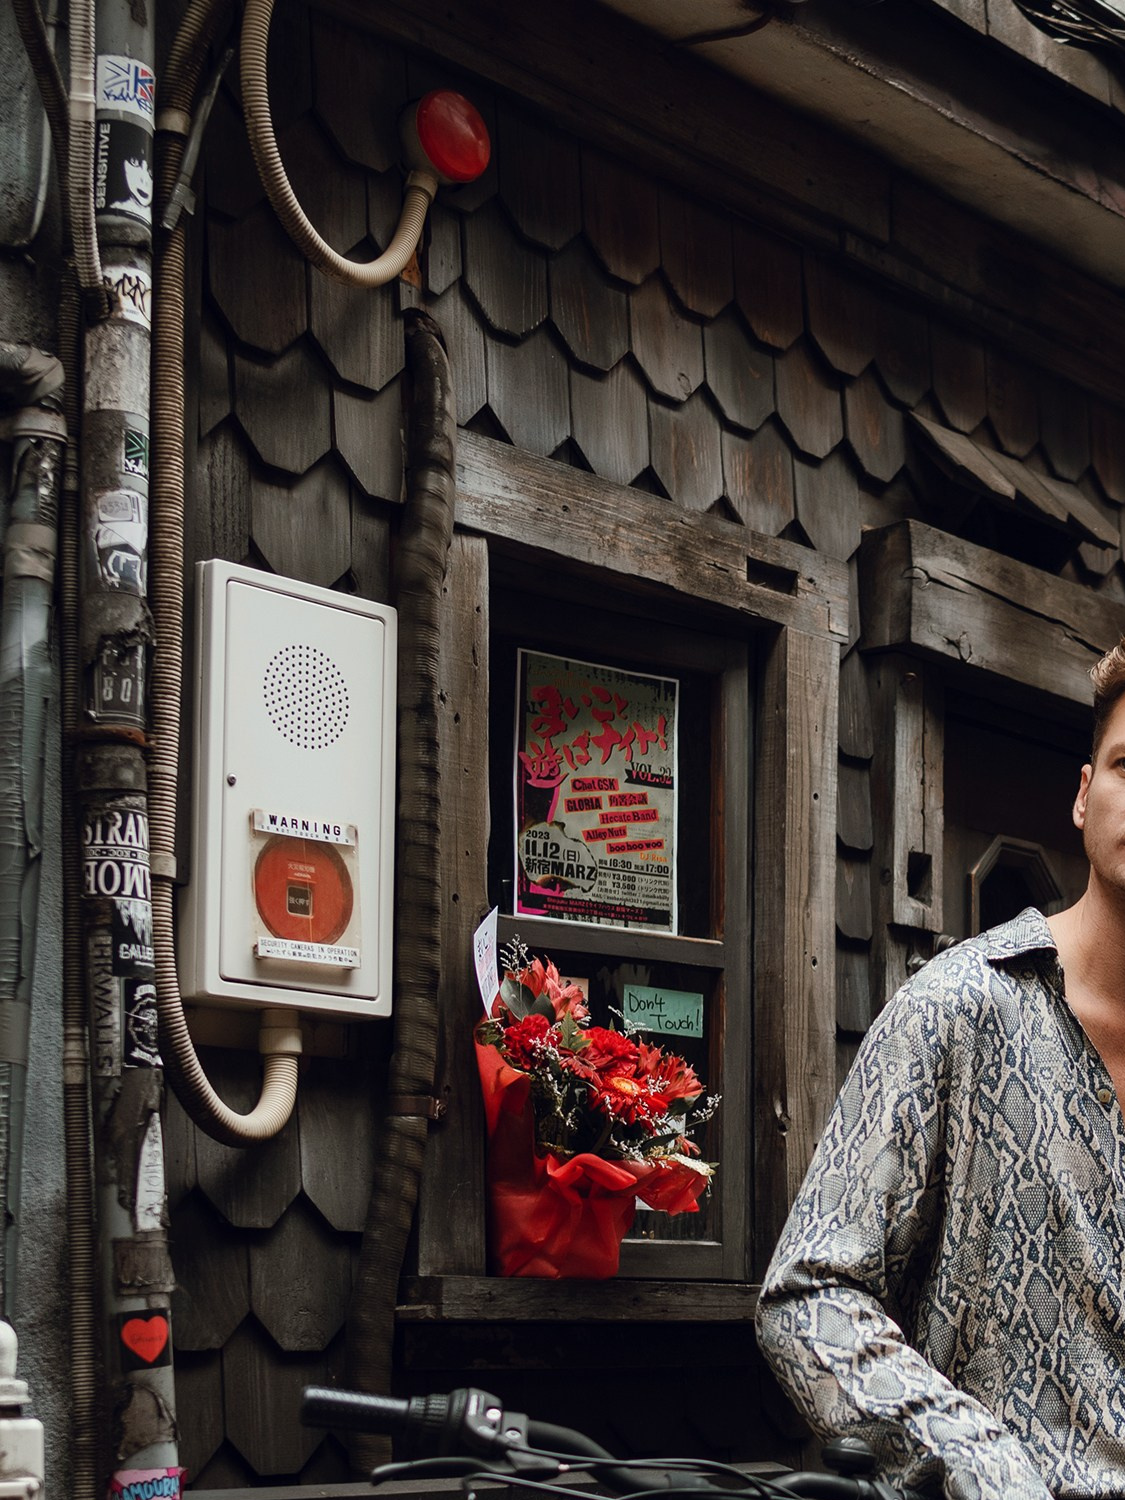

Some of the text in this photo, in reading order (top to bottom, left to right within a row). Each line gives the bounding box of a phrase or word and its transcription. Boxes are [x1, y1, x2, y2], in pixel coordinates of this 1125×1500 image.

[95, 122, 111, 209] SENSITIVE
[631, 761, 672, 784] VOL.32
[572, 778, 617, 791] Chat GSK
[566, 798, 602, 812] GLORIA
[269, 814, 341, 836] WARNING
[601, 810, 657, 824] Hecate Band
[526, 830, 550, 840] 2023
[586, 831, 607, 842] Alley
[607, 827, 627, 837] Nuts
[525, 839, 560, 860] 11.12
[609, 843, 626, 852] boo
[525, 857, 597, 881] 新宿MARZ
[609, 859, 632, 870] 16:30
[646, 864, 669, 874] 17:00
[260, 939, 287, 948] SECURITY
[291, 943, 314, 952] CAMERAS
[327, 948, 358, 957] OPERATION
[650, 1008, 700, 1032] Touch!
